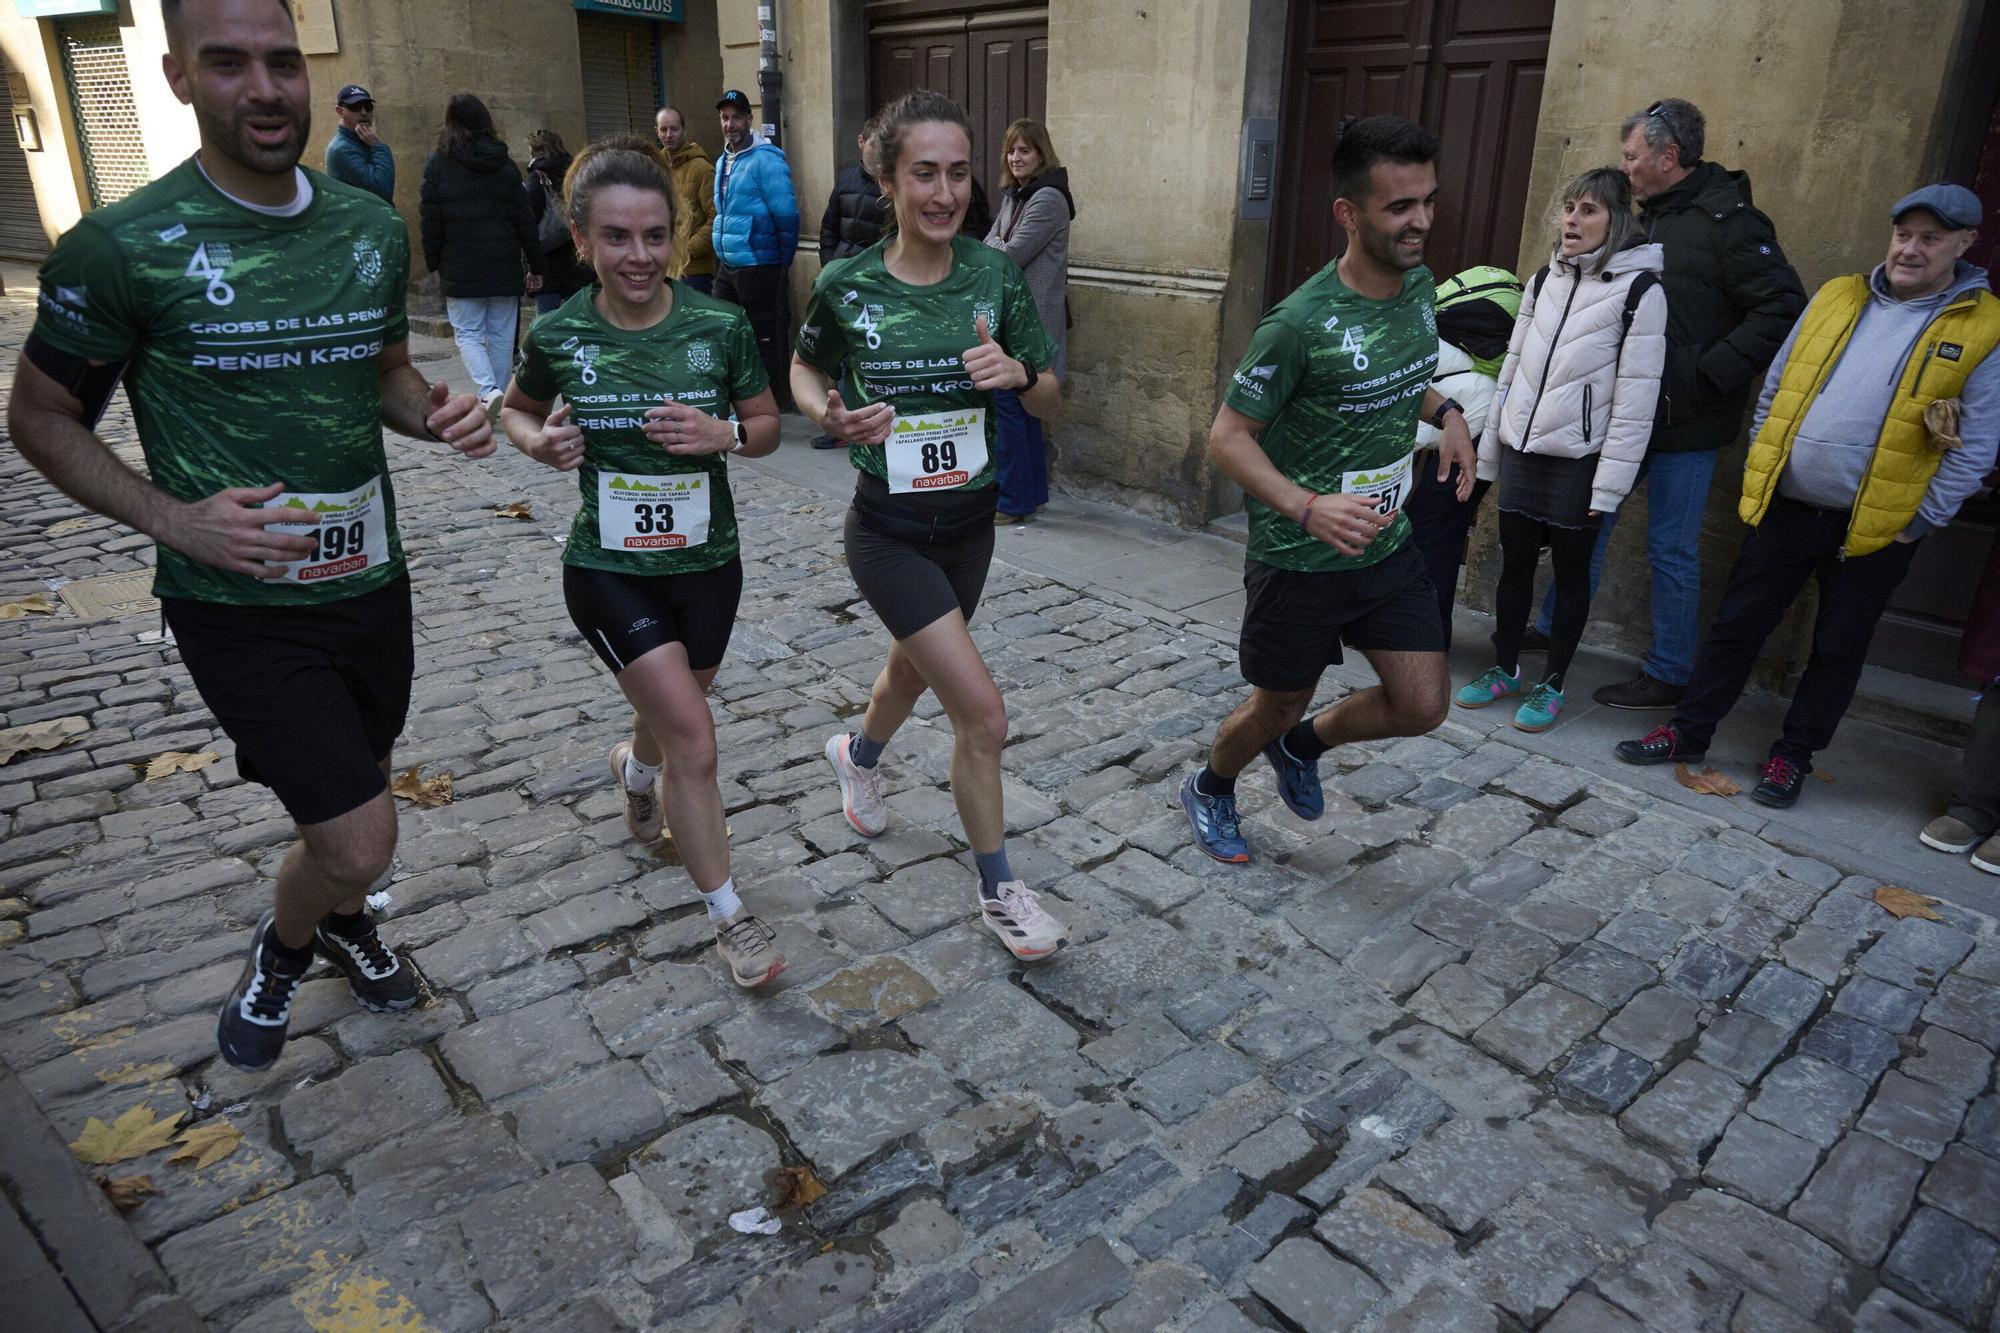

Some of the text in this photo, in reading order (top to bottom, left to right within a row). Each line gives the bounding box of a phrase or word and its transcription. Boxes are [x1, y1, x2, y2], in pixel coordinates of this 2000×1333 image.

[188, 320, 270, 334] CROSS
[275, 317, 301, 331] DE
[305, 313, 344, 328] LAS
[192, 352, 302, 371] PEÑEN
[860, 360, 902, 371] CROSS
[905, 359, 925, 369] DE
[928, 357, 957, 367] LAS
[1341, 375, 1388, 391] CROSS
[1389, 369, 1402, 381] DE
[1403, 359, 1423, 374] LAS
[621, 393, 640, 402] DE
[644, 392, 674, 401] LAS
[677, 389, 717, 400] PEÑAS
[864, 377, 978, 395] PEÑEN KRO
[1338, 392, 1400, 413] PEÑEN
[577, 415, 643, 430] PEÑEN
[921, 440, 957, 474] 89
[915, 473, 967, 487] navarban
[634, 503, 674, 533] 33
[304, 520, 365, 562] 199
[627, 536, 684, 547] navarban
[302, 557, 366, 579] navarban
